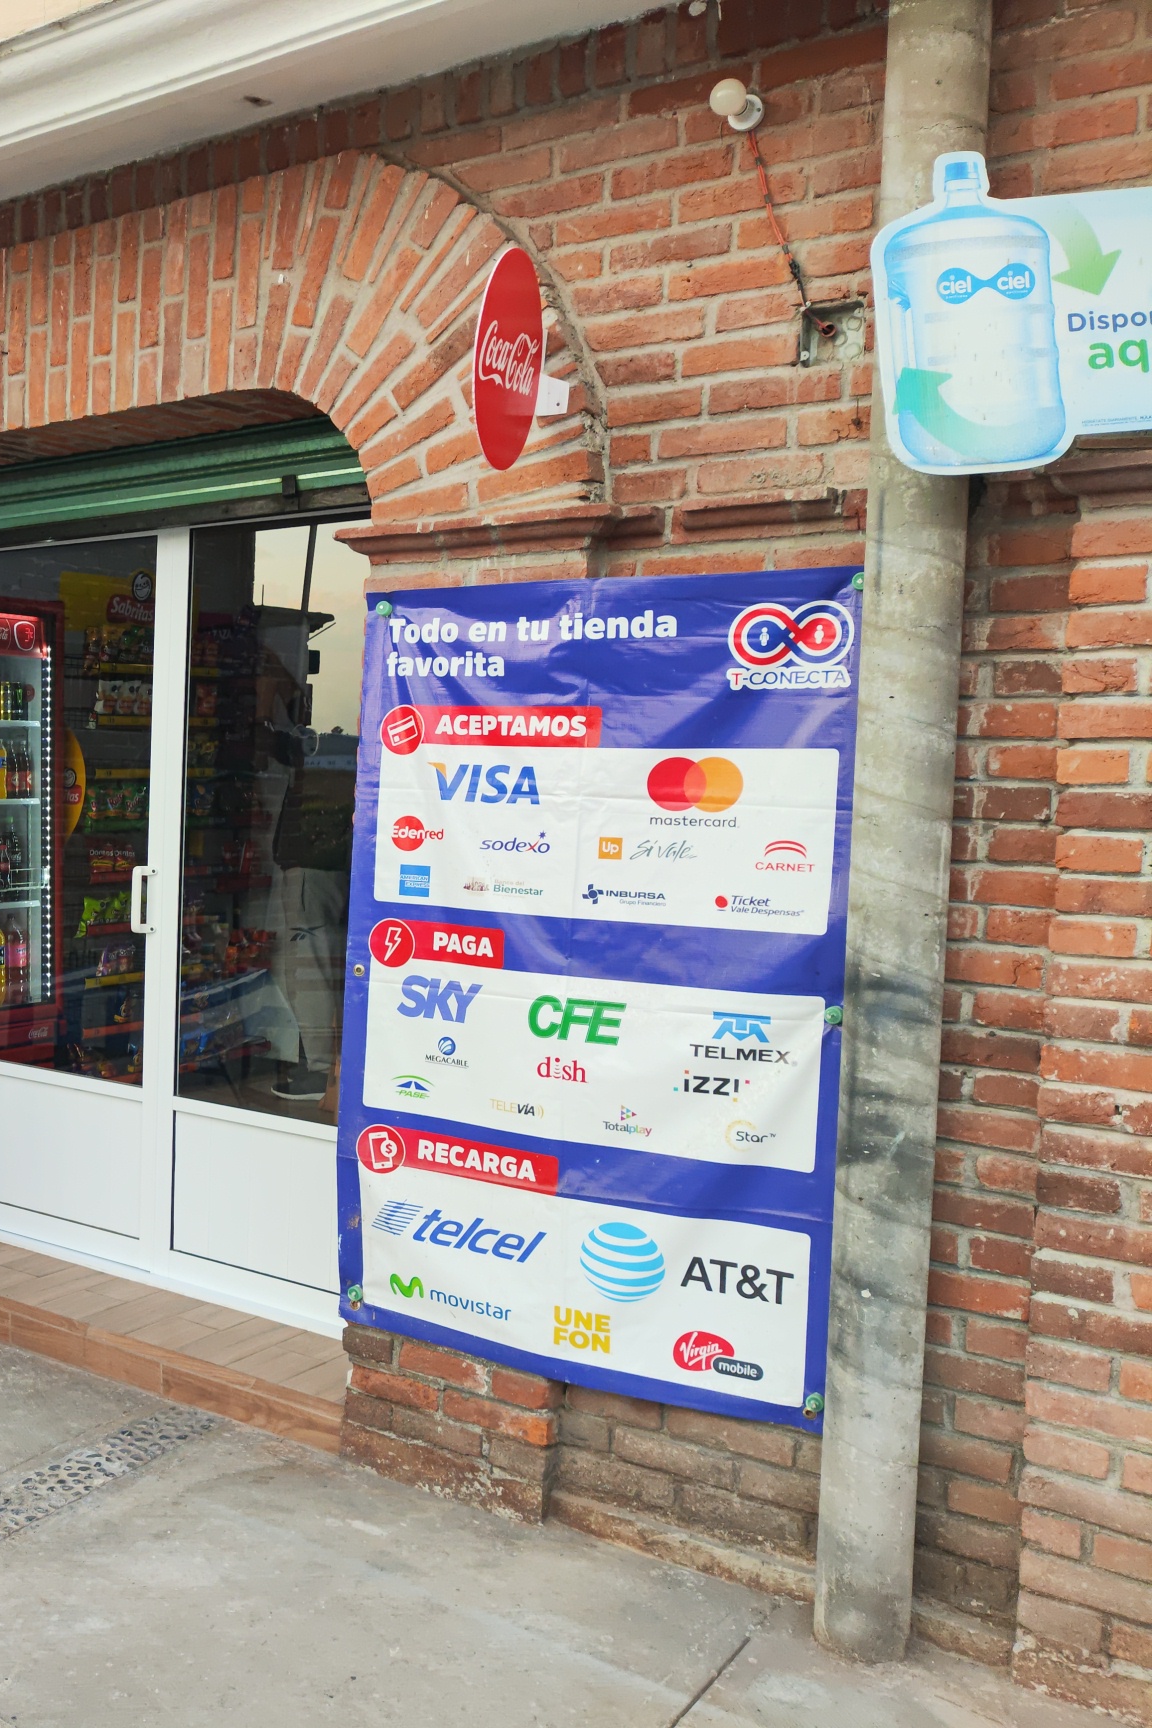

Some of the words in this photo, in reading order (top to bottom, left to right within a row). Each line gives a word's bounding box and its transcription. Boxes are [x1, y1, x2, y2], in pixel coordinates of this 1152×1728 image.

[939, 275, 972, 294] ciel
[997, 271, 1030, 290] ciel
[1068, 310, 1152, 332] Dispo
[478, 320, 540, 396] Coca-Cola
[1088, 338, 1150, 373] aq
[110, 597, 153, 621] Sabritas
[389, 617, 459, 644] Todo
[468, 621, 507, 642] en
[517, 616, 550, 641] tu
[559, 609, 678, 640] tienda
[386, 651, 505, 677] favorita
[731, 669, 847, 686] T-CONECTA
[434, 714, 587, 737] ACEPTAMOS
[427, 762, 540, 805] VISA
[391, 825, 444, 840] Edenred
[649, 816, 738, 828] mastercard
[479, 835, 551, 853] sodexo
[602, 840, 619, 855] Up
[755, 861, 816, 873] CARNET
[493, 885, 544, 896] Bienestar
[606, 889, 666, 900] INBURSA
[732, 895, 771, 907] Ticket
[731, 906, 750, 914] Vale
[750, 907, 802, 917] Despensas
[433, 931, 494, 957] PAGA
[397, 974, 483, 1023] SKY
[528, 994, 627, 1046] CFE
[425, 1054, 469, 1067] MEGACABLE
[689, 1044, 790, 1064] TELMEX
[537, 1056, 588, 1083] dish
[603, 1120, 652, 1137] Totalplay
[735, 1131, 768, 1143] Star
[417, 1139, 536, 1182] RECARGA
[412, 1209, 547, 1263] telcel
[680, 1256, 794, 1305] AT&T
[430, 1289, 512, 1321] movistar
[553, 1305, 611, 1333] UNE
[553, 1326, 611, 1354] FON
[679, 1332, 723, 1370] Virgin
[718, 1359, 758, 1378] mobile
